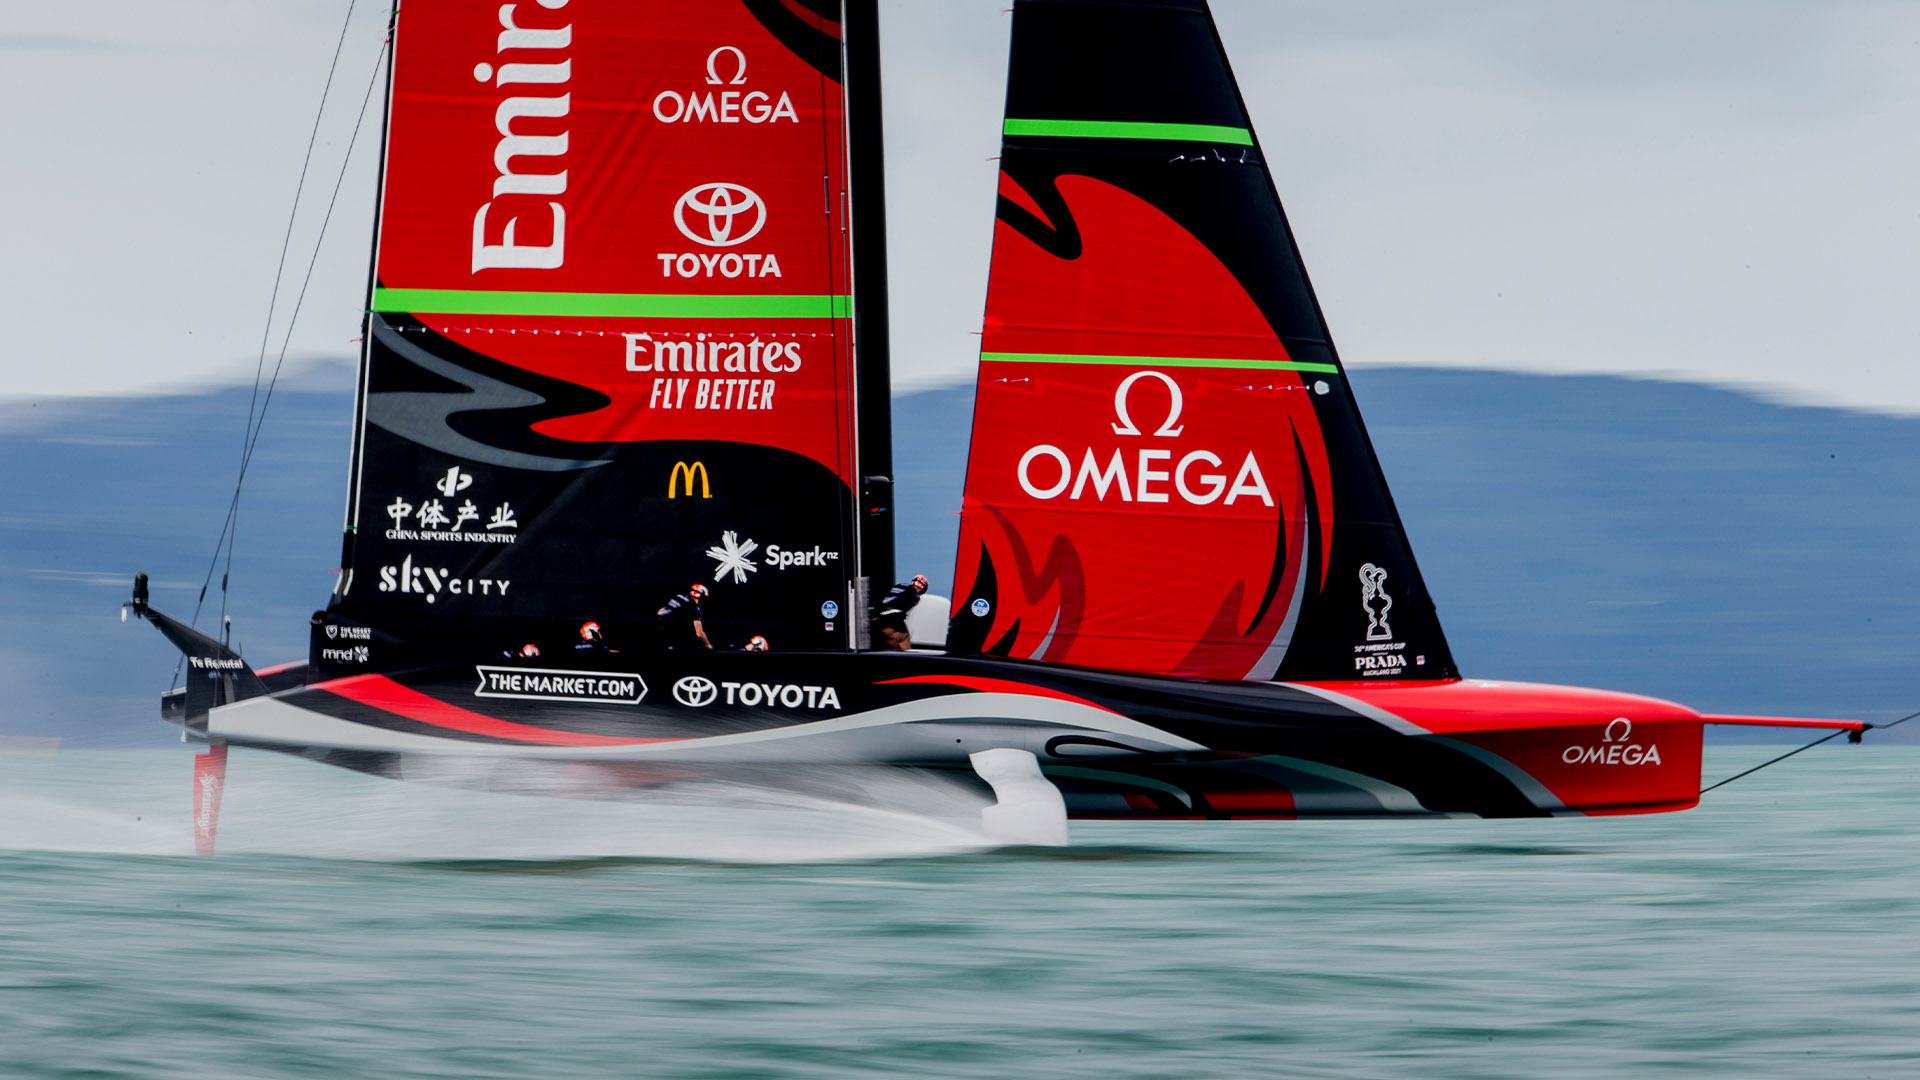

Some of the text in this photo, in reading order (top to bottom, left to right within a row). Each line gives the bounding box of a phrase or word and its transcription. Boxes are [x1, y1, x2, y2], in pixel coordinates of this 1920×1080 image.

[653, 90, 799, 124] OMEGA
[472, 0, 572, 275] Emir
[657, 253, 782, 278] TOYOTA
[625, 333, 802, 373] Emirates
[650, 378, 775, 410] FLY BETTER
[1017, 444, 1275, 507] OMEGA
[387, 496, 518, 532] 中体产业
[385, 528, 517, 544] CHINA SPORTS INDUSTRY
[322, 648, 353, 661] mnd
[1355, 654, 1407, 670] PRADA
[488, 673, 635, 697] THE MARKET.COM
[721, 681, 842, 710] TOYOTA
[1561, 739, 1662, 766] OMEGA
